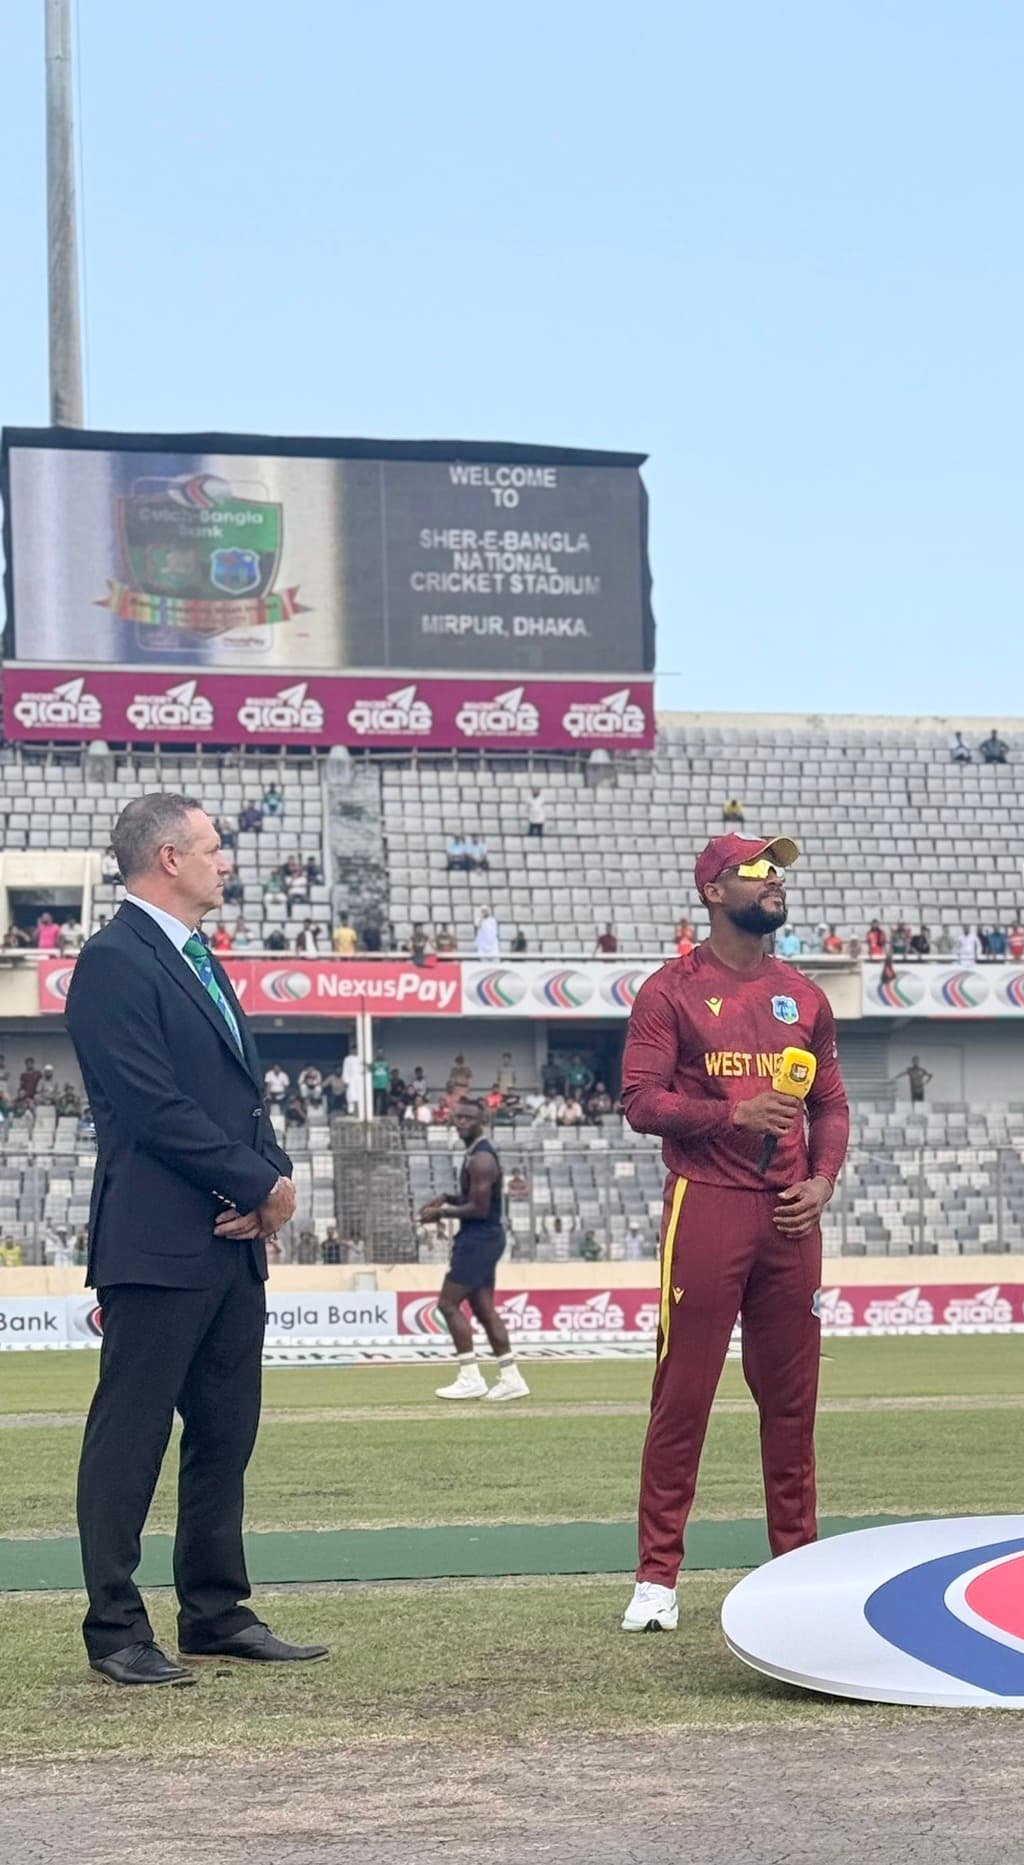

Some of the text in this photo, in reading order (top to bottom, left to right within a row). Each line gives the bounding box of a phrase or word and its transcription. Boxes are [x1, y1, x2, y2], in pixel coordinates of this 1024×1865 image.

[449, 466, 557, 487] WELCOME
[491, 488, 519, 508] TO
[419, 529, 591, 552] SHER-E-BANGLA
[453, 551, 558, 573] NATIONAL
[410, 571, 600, 595] CRICKET STADIUM
[421, 614, 509, 638] MIRPUR,
[317, 972, 457, 1008] NexusPay
[705, 1051, 752, 1077] WEST
[328, 1305, 389, 1325] Bank
